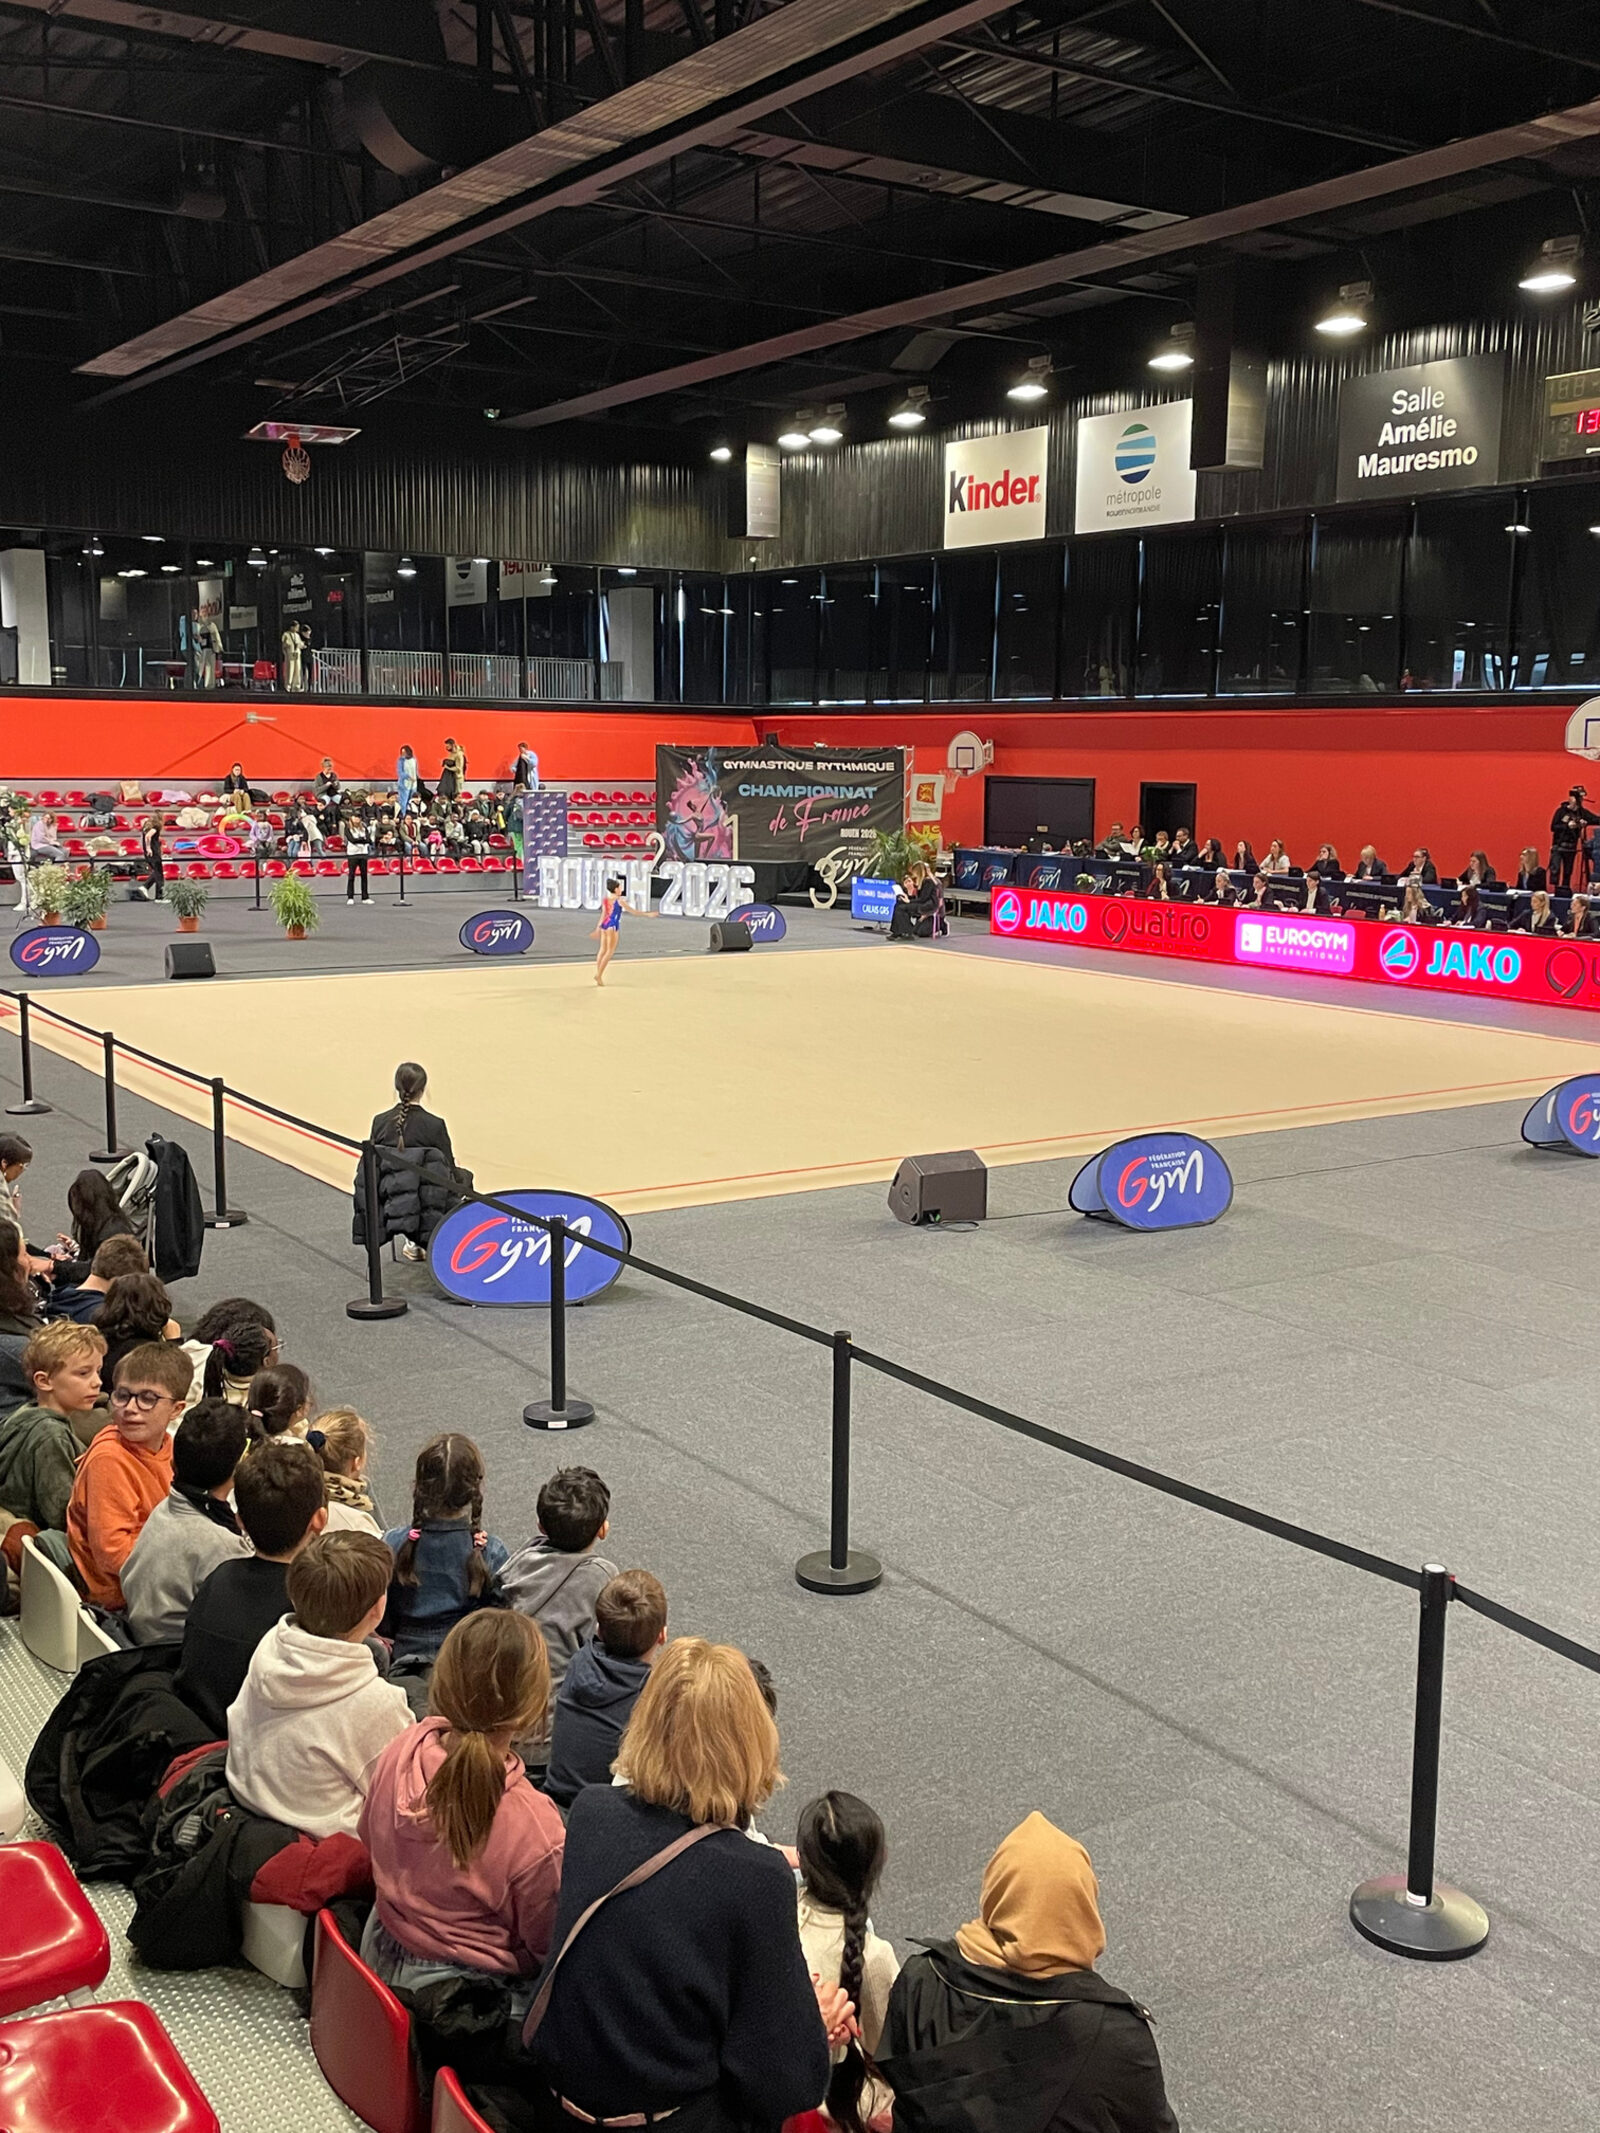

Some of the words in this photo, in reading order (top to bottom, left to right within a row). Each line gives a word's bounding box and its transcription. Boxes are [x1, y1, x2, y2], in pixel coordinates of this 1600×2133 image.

[1391, 385, 1445, 416] Salle
[1377, 415, 1458, 448] Amélie
[1357, 446, 1478, 479] Mauresmo
[1106, 486, 1162, 505] métropole
[723, 760, 814, 772] GYMNASTIQUE
[816, 761, 895, 773] RYTHMIQUE
[738, 784, 878, 800] CHAMPIONNAT
[768, 804, 788, 837] de
[793, 793, 872, 843] France
[840, 828, 860, 838] ROUEN
[659, 861, 755, 919] 2026
[1026, 899, 1088, 933] JAKO
[1101, 902, 1211, 944] Quatro
[473, 919, 522, 947] Gym
[1266, 926, 1348, 951] EUROGYM
[21, 936, 86, 967] Gym
[1265, 946, 1346, 962] INTERNATIONAL
[1427, 940, 1522, 984] JAKO
[1148, 1151, 1186, 1162] FÉDÉRATION
[1151, 1158, 1185, 1169] FRANÇAISE
[1117, 1149, 1204, 1212] Gym
[450, 1215, 592, 1284] Gym
